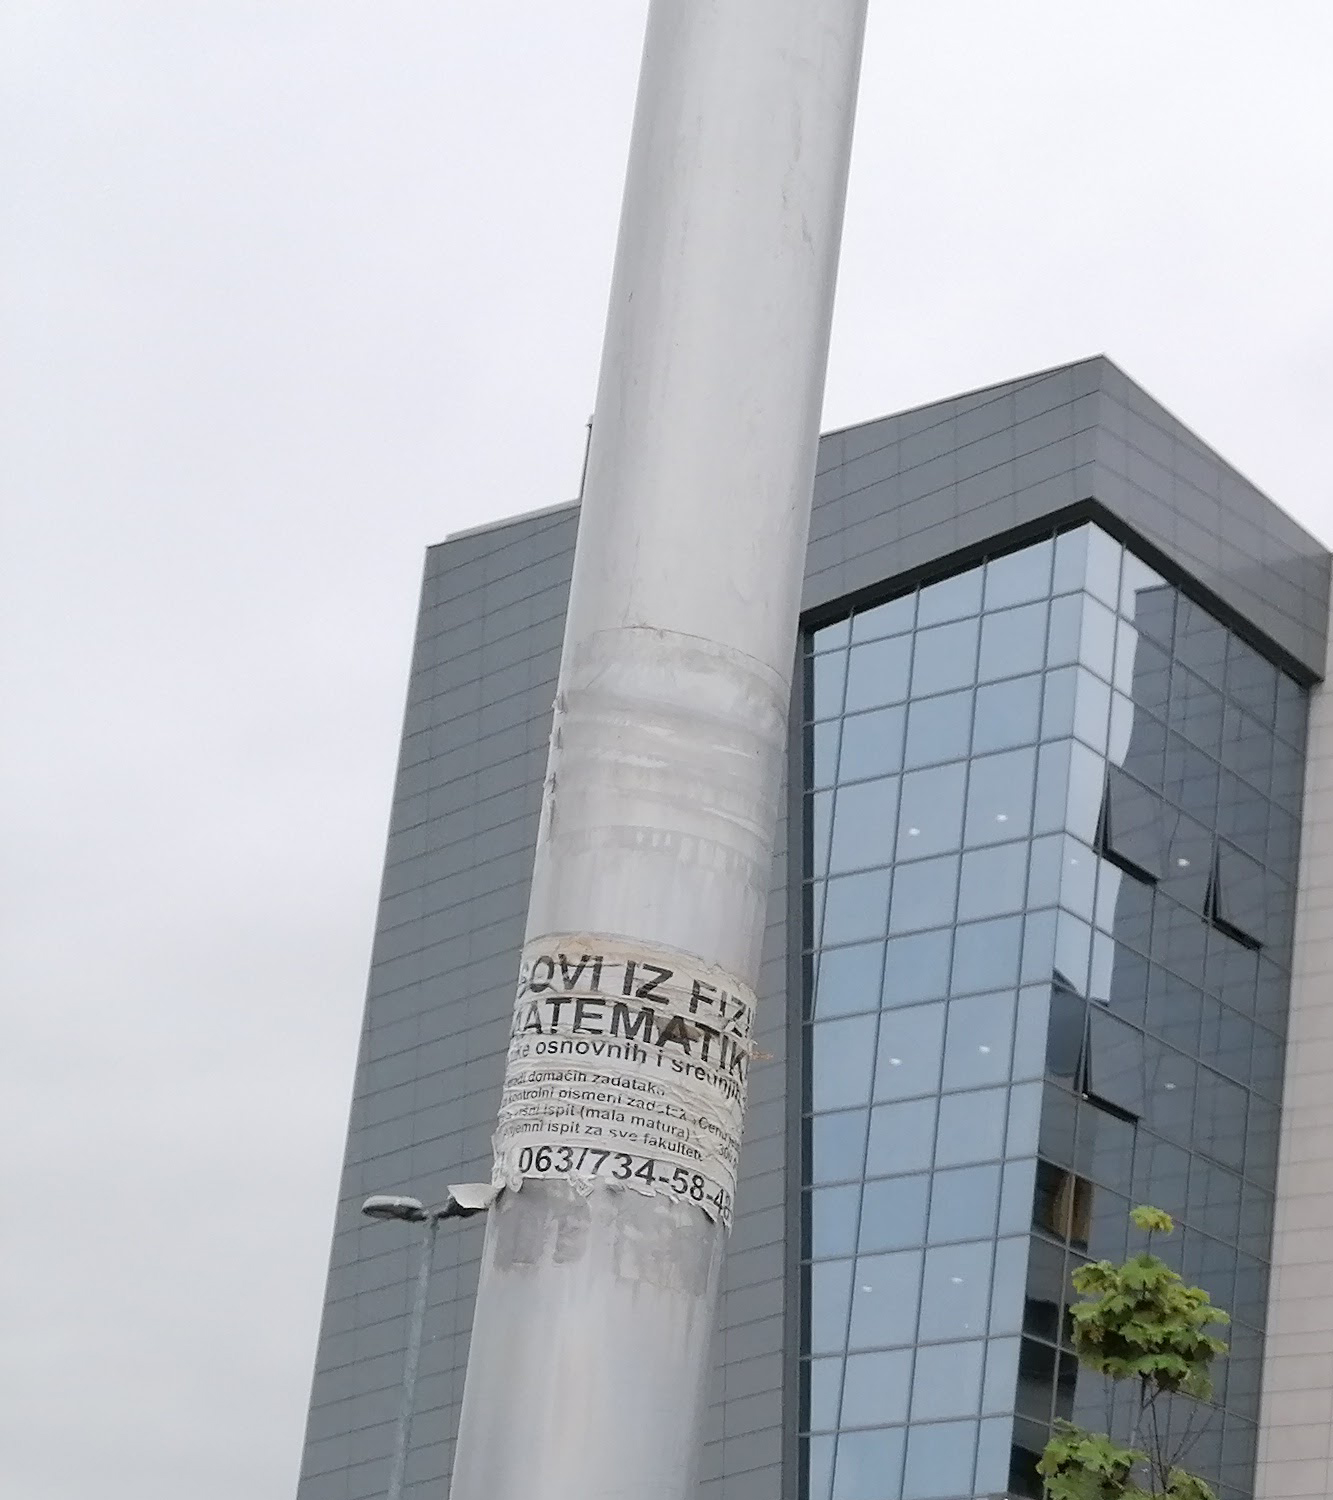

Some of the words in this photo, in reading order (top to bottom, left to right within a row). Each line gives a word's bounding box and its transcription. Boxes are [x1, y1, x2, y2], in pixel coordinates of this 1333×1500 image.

[519, 953, 603, 993] OVI
[622, 960, 673, 1005] IZ
[513, 997, 746, 1084] ATEMATIK
[536, 1041, 647, 1064] osnovnih
[547, 1121, 580, 1135] ispit
[584, 1125, 603, 1136] za
[609, 1128, 638, 1142] sve
[580, 1105, 626, 1123] (mala
[631, 1115, 690, 1141] matura)
